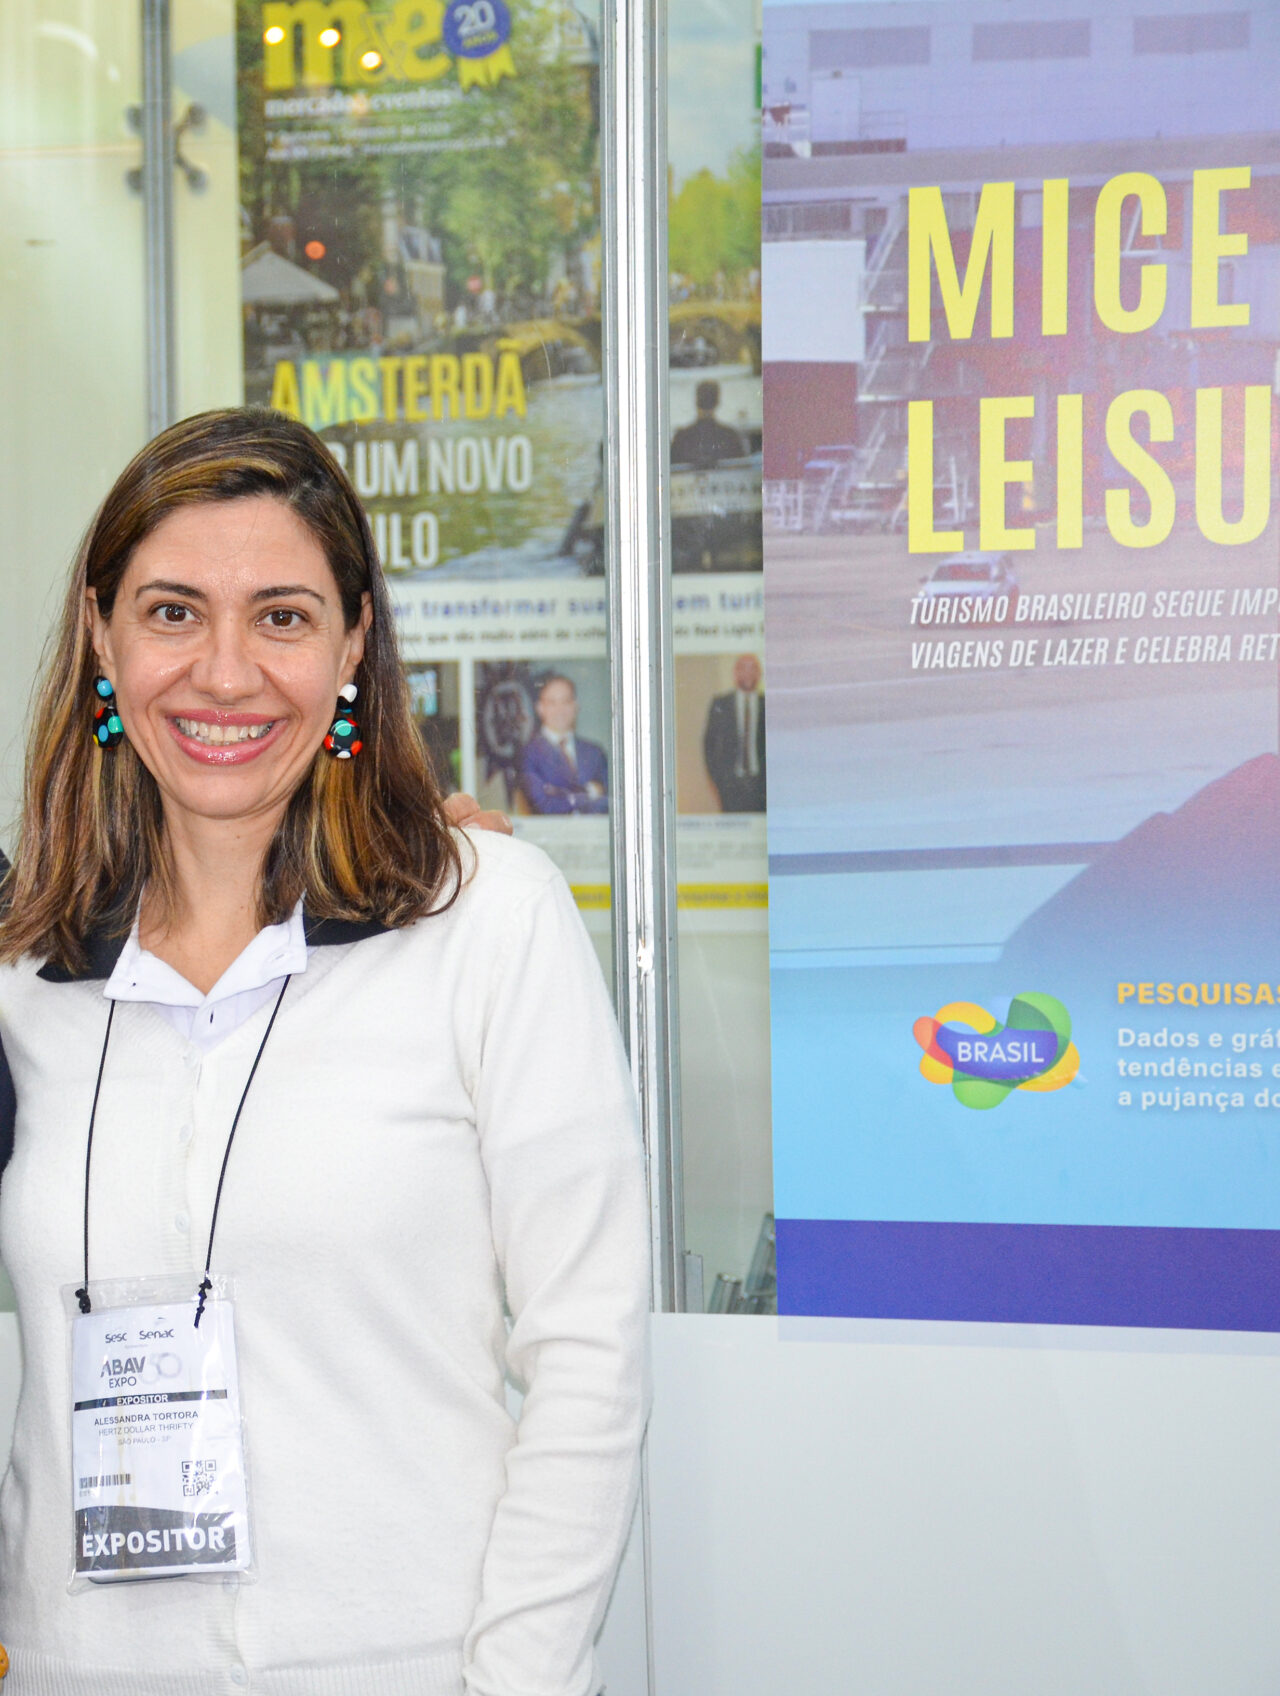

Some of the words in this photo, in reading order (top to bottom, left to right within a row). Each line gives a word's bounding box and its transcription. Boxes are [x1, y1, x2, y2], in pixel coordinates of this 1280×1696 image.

[453, 0, 496, 37] 20
[908, 166, 1252, 342] MICE
[271, 338, 528, 427] AMSTERDÃ
[354, 439, 419, 497] UM
[426, 434, 533, 495] NOVO
[908, 384, 1272, 553] LEISU
[910, 597, 1008, 625] TURISMO
[1014, 591, 1147, 622] BRASILEIRO
[1152, 589, 1226, 618] SEGUE
[1230, 587, 1280, 616] IMP
[911, 640, 1003, 669] VIAGENS
[1008, 639, 1038, 667] DE
[1042, 637, 1110, 666] LAZER
[1114, 636, 1129, 664] E
[1133, 634, 1231, 664] CELEBRA
[1117, 982, 1280, 1008] PESQUISA
[1117, 1027, 1200, 1048] Dados
[1208, 1032, 1223, 1048] e
[957, 1041, 1045, 1063] BRASIL
[1117, 1057, 1263, 1078] tendências
[1117, 1090, 1132, 1106] a
[1141, 1086, 1245, 1113] pujança
[100, 1356, 147, 1378] ABAV
[108, 1376, 137, 1389] EXPO
[116, 1394, 169, 1407] EXPOSITOR
[94, 1413, 151, 1426] ALESSANDRA
[153, 1410, 199, 1421] TORTORA
[98, 1427, 122, 1437] HERTZ
[123, 1424, 156, 1434] DOLLAR
[159, 1422, 194, 1432] THRIFTY
[82, 1526, 227, 1559] EXPOSITOR
